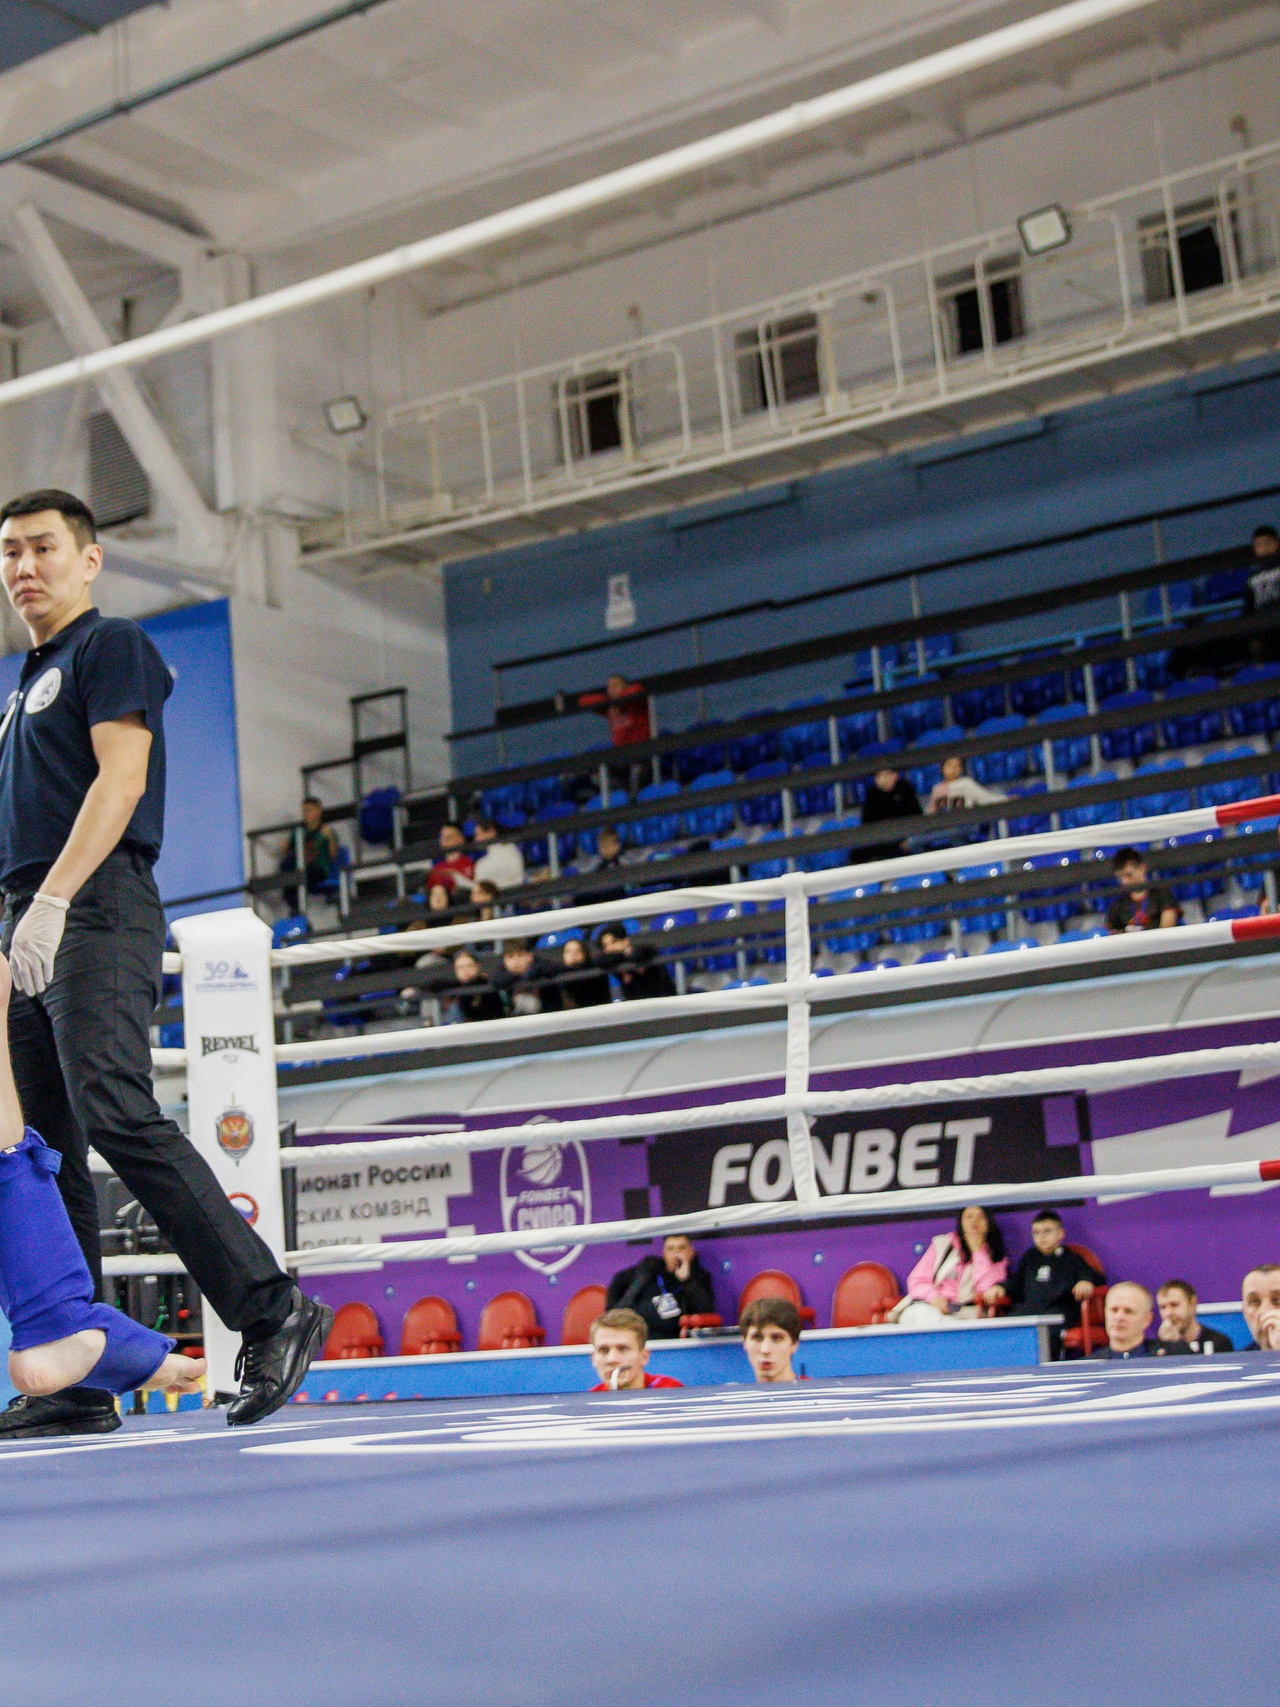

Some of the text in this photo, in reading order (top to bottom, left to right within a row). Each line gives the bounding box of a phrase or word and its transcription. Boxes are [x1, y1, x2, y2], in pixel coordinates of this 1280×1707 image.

[200, 1034, 260, 1057] REYVEL
[368, 1161, 452, 1186] России
[707, 1116, 993, 1208] FONBET
[349, 1196, 432, 1219] команд
